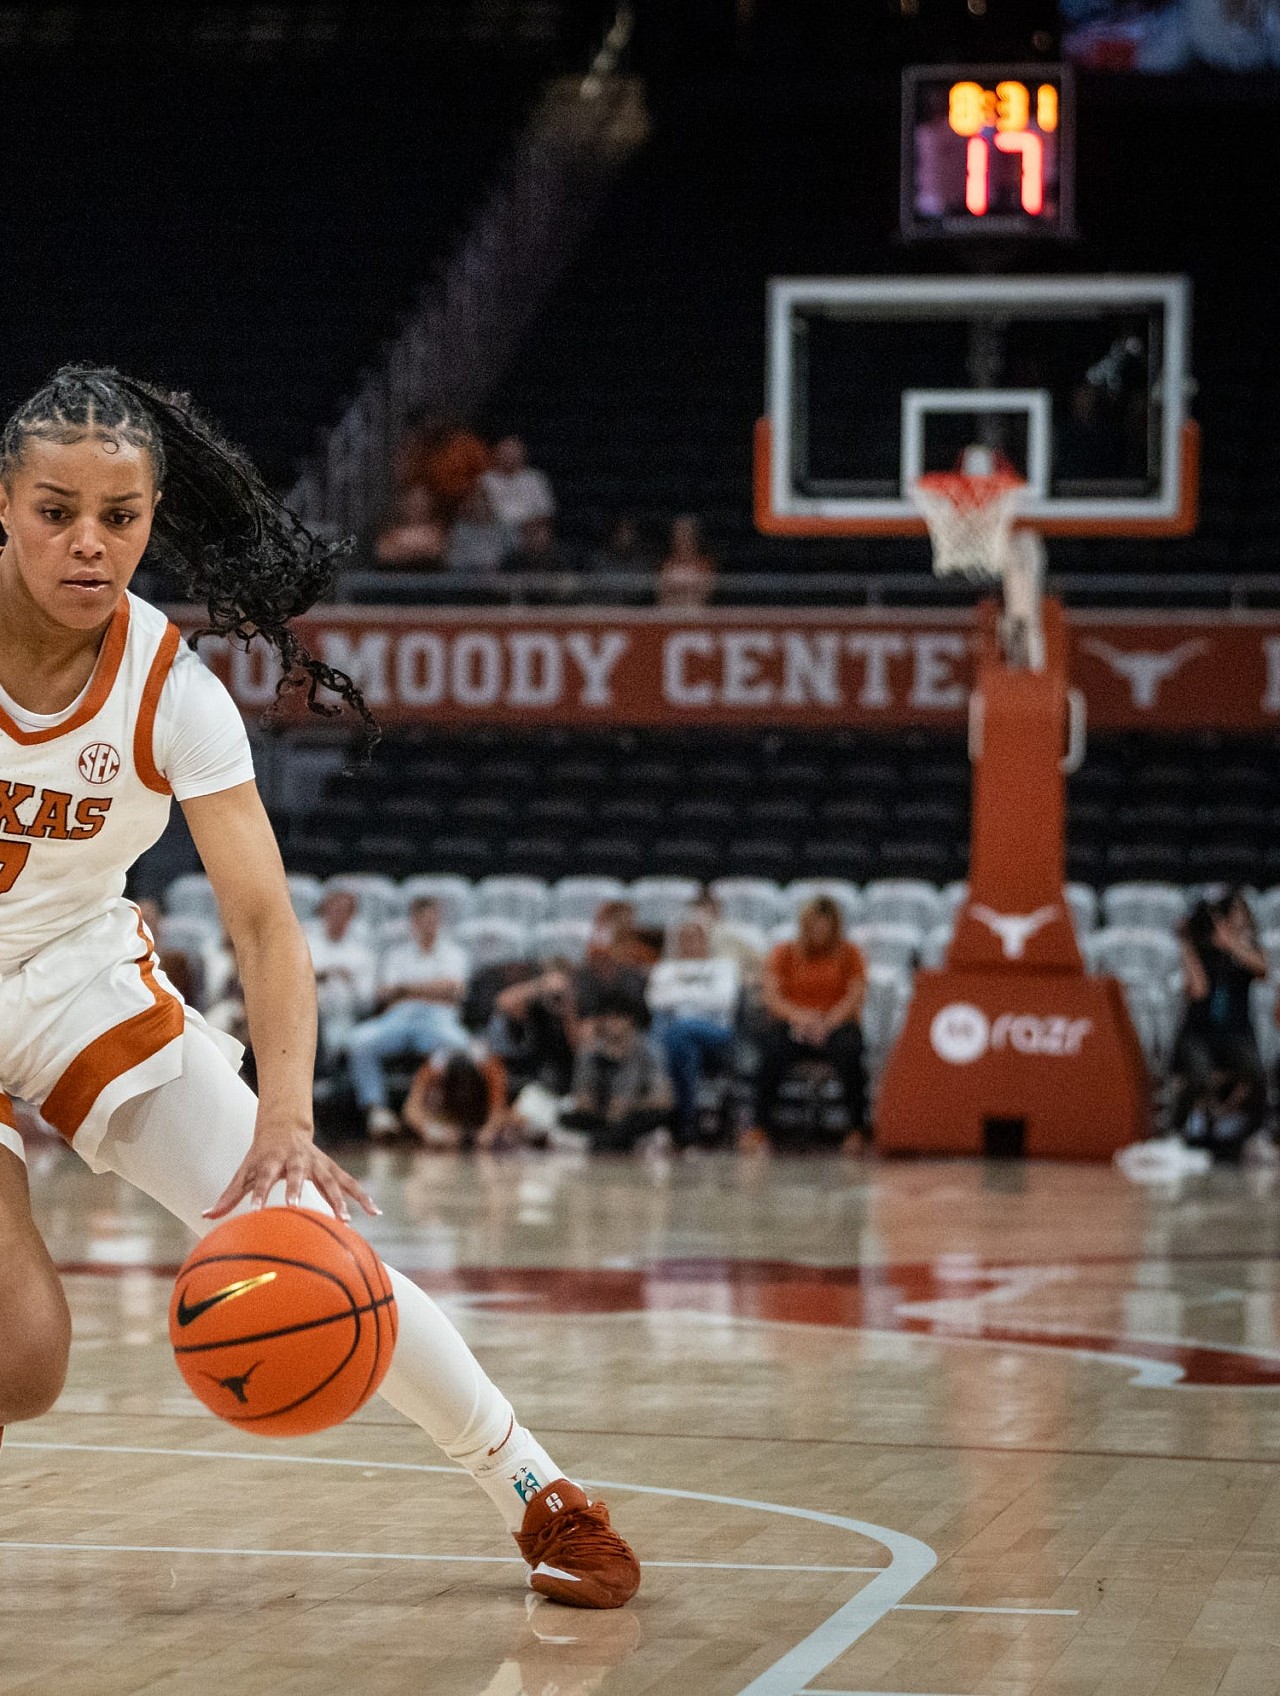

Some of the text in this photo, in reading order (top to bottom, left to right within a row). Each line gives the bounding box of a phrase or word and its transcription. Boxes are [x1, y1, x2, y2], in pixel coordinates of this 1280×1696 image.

[965, 131, 1043, 216] 17
[320, 630, 628, 708] MOODY
[79, 743, 120, 784] SEC
